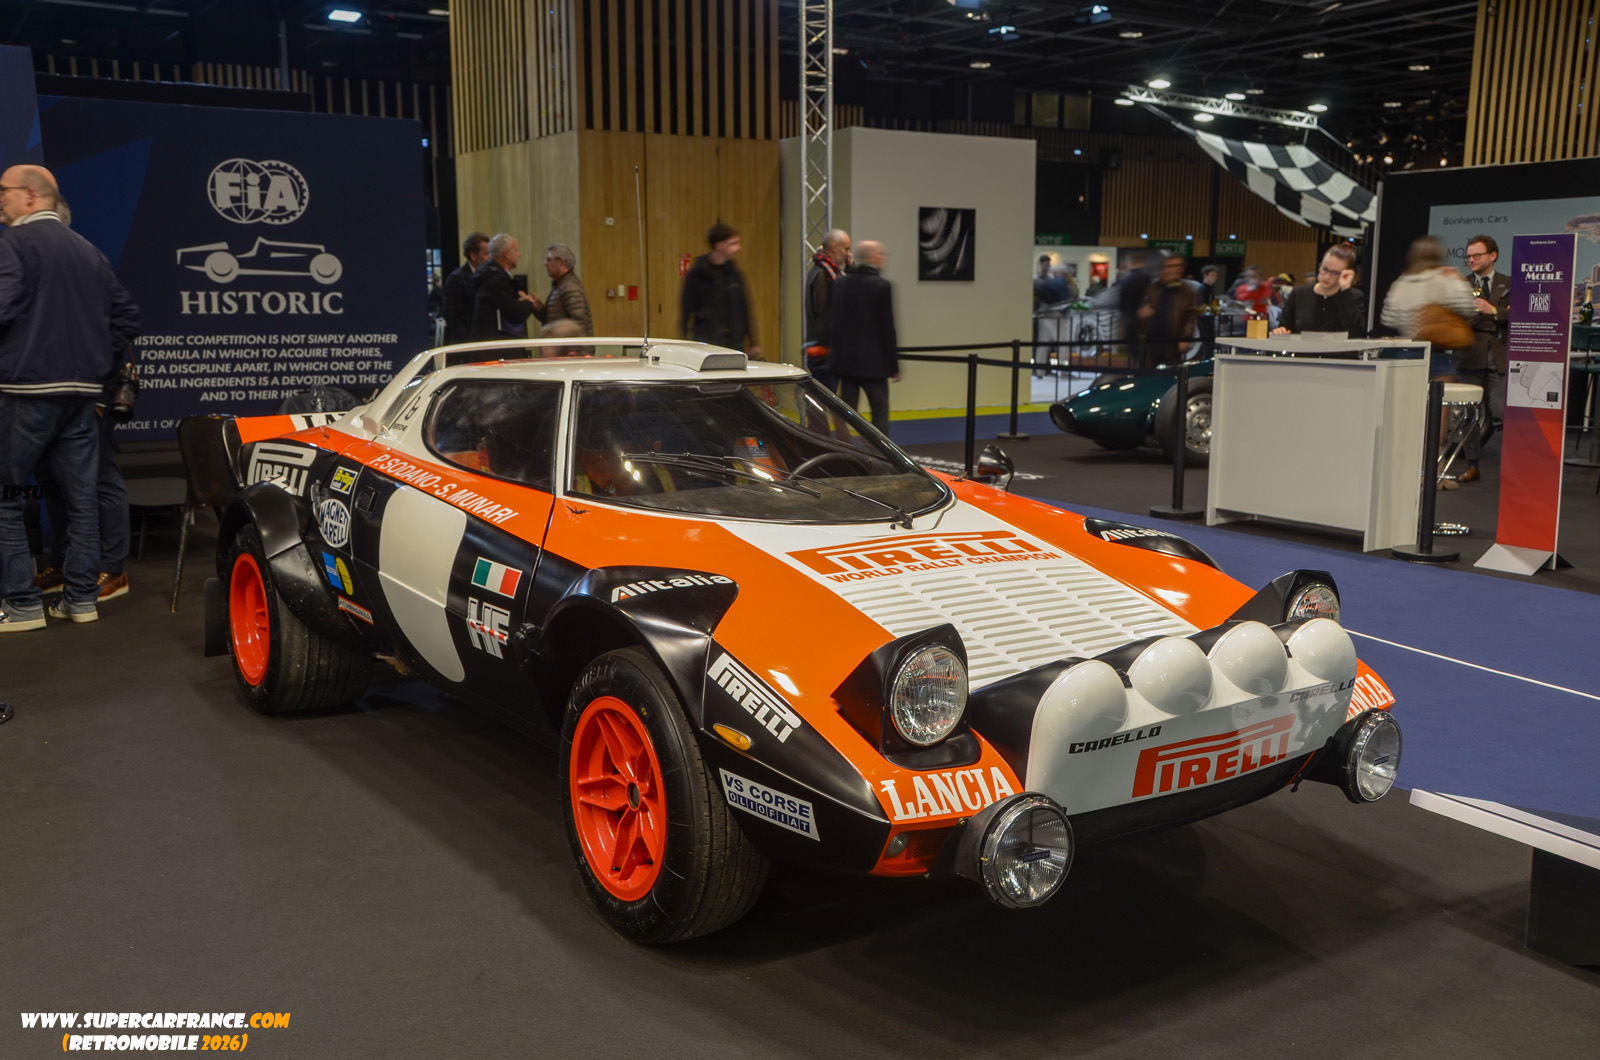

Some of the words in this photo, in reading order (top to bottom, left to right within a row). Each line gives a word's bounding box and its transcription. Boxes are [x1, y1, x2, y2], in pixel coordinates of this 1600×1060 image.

[1443, 216, 1484, 226] Bonhams
[1487, 215, 1508, 224] Cars
[1215, 242, 1245, 254] SORTIE
[180, 291, 343, 315] HISTORIC
[1529, 294, 1549, 312] PARIS
[186, 334, 266, 346] COMPETITION
[268, 334, 279, 345] IS
[280, 334, 306, 345] NOT
[308, 334, 345, 344] SIMPLY
[347, 333, 398, 344] ANOTHER
[141, 349, 200, 361] FORMULA
[202, 349, 216, 359] IN
[218, 348, 259, 359] WHICH
[261, 348, 277, 358] TO
[279, 347, 328, 359] ACQUIRE
[330, 347, 382, 358] TROPHIES,
[144, 364, 155, 374] IS
[157, 364, 167, 374] A
[169, 363, 232, 374] DISCIPLINE
[233, 362, 271, 373] APART,
[273, 362, 287, 372] IN
[289, 361, 328, 372] WHICH
[330, 361, 355, 371] ONE
[356, 361, 371, 371] OF
[373, 360, 393, 370] THE
[139, 378, 178, 389] ENTIAL
[180, 376, 256, 388] INGREDIENTS
[258, 376, 269, 386] IS
[270, 376, 280, 386] A
[282, 375, 340, 386] DEVOTION
[342, 374, 357, 384] TO
[358, 374, 377, 384] THE
[379, 374, 396, 384] CA
[200, 391, 228, 402] AND
[230, 391, 246, 401] TO
[248, 389, 278, 400] THEIR
[160, 420, 175, 430] OF
[247, 442, 317, 497] PIRELLI
[785, 530, 1044, 575] PIRELLI
[826, 567, 904, 583] WORLD
[903, 556, 964, 573] RALLY
[970, 551, 1062, 566] CHAMPION
[611, 575, 733, 603] Alitalia
[707, 652, 801, 744] PIRELLI
[1289, 676, 1355, 704] CARELLO
[1068, 726, 1162, 755] CARELLO
[1131, 713, 1296, 798] PIRELLI
[724, 773, 744, 793] VS
[749, 785, 811, 819] CORSE
[881, 766, 1015, 821] LANCIA
